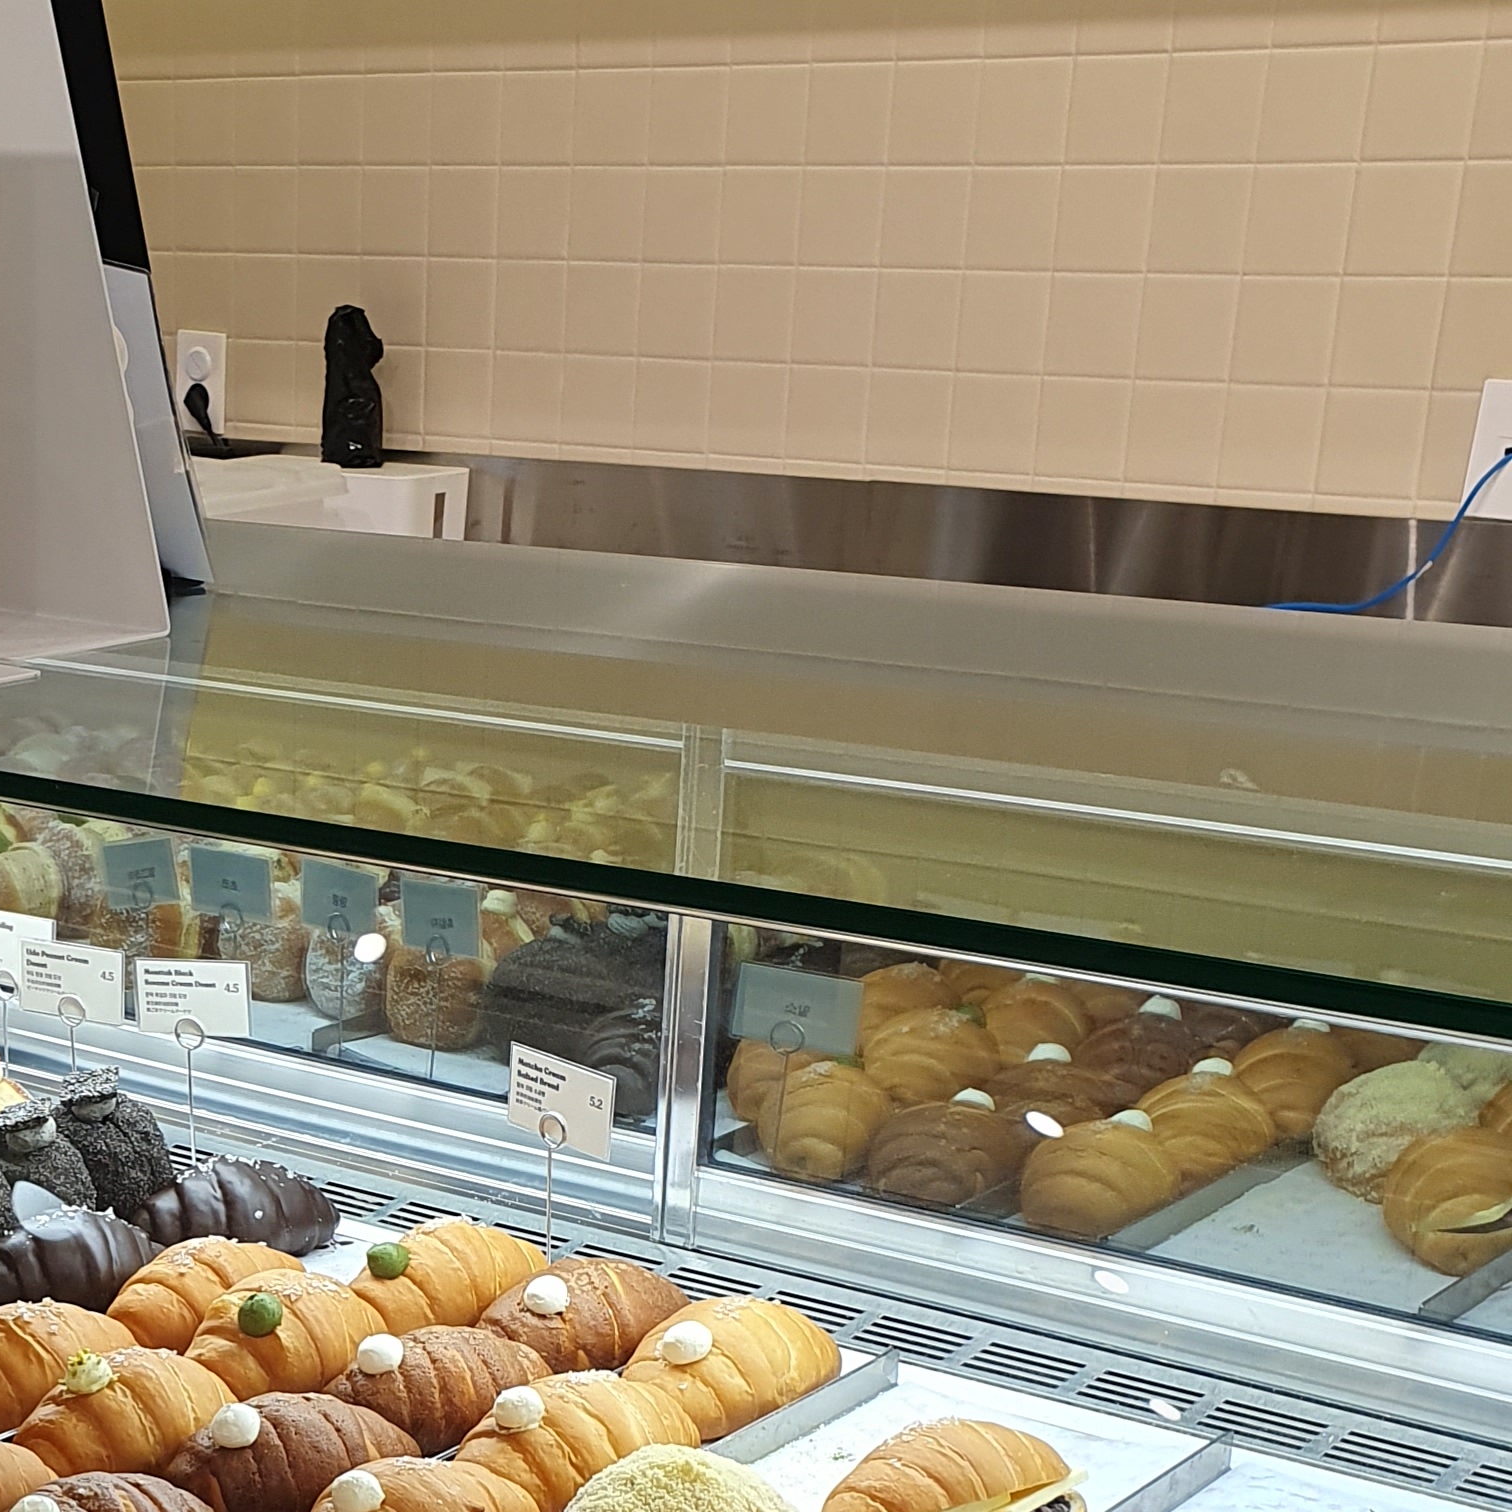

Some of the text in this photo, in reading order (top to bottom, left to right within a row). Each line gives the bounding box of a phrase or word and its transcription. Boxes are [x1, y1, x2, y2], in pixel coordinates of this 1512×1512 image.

[26, 959, 48, 969] Donut
[66, 954, 89, 964] Cream
[100, 970, 114, 981] 4.5
[224, 983, 239, 993] 4.5
[518, 1057, 566, 1082] Matcha Cream
[517, 1069, 559, 1091] Salted Bread
[589, 1096, 603, 1110] 5.2
